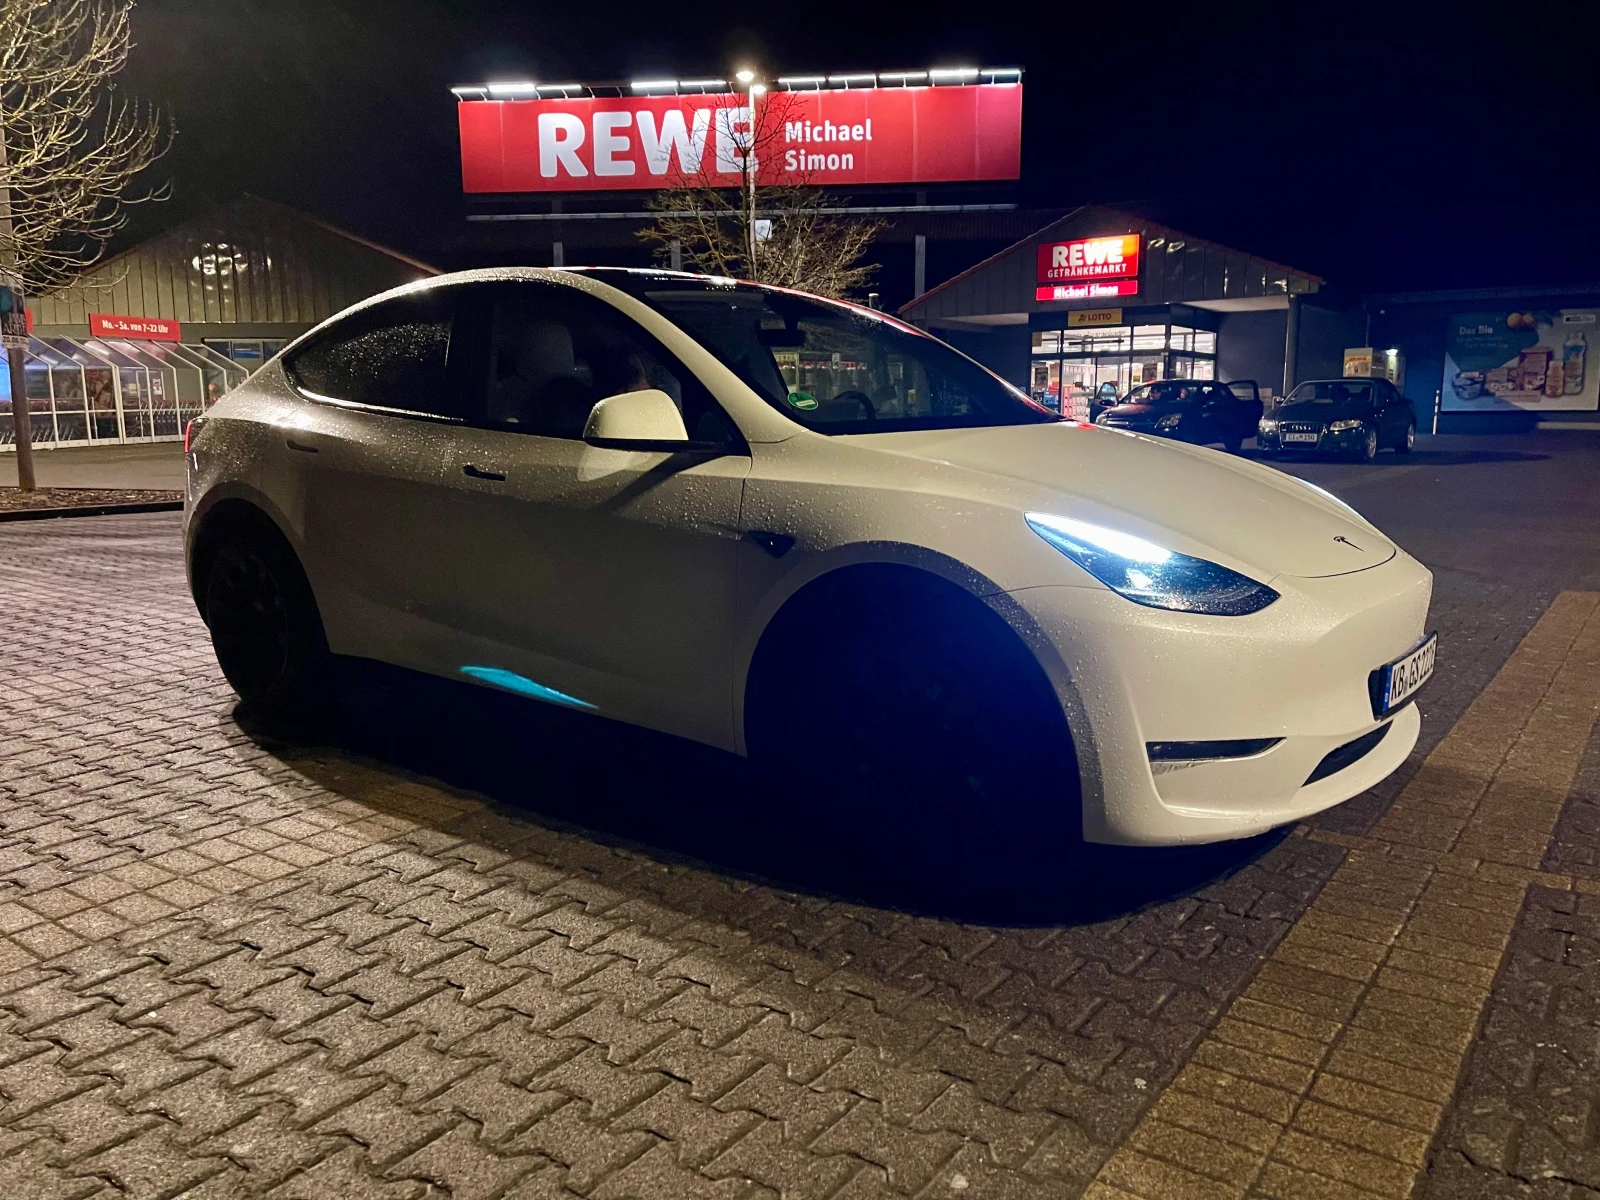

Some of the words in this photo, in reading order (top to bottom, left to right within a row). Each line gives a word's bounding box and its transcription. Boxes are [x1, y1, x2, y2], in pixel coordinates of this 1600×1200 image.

[784, 118, 873, 144] Michael
[538, 107, 758, 178] REWE
[784, 150, 855, 173] Simon
[1052, 240, 1124, 268] REWE
[1047, 263, 1128, 278] GETRÄNKEMARKT
[1053, 285, 1089, 299] Michael
[1089, 284, 1119, 297] Simon
[1087, 312, 1112, 321] LOTTO
[130, 323, 142, 332] von
[157, 324, 169, 334] Uhr
[1460, 326, 1476, 335] Das
[1478, 324, 1493, 335] Bio
[1391, 664, 1406, 702] KB
